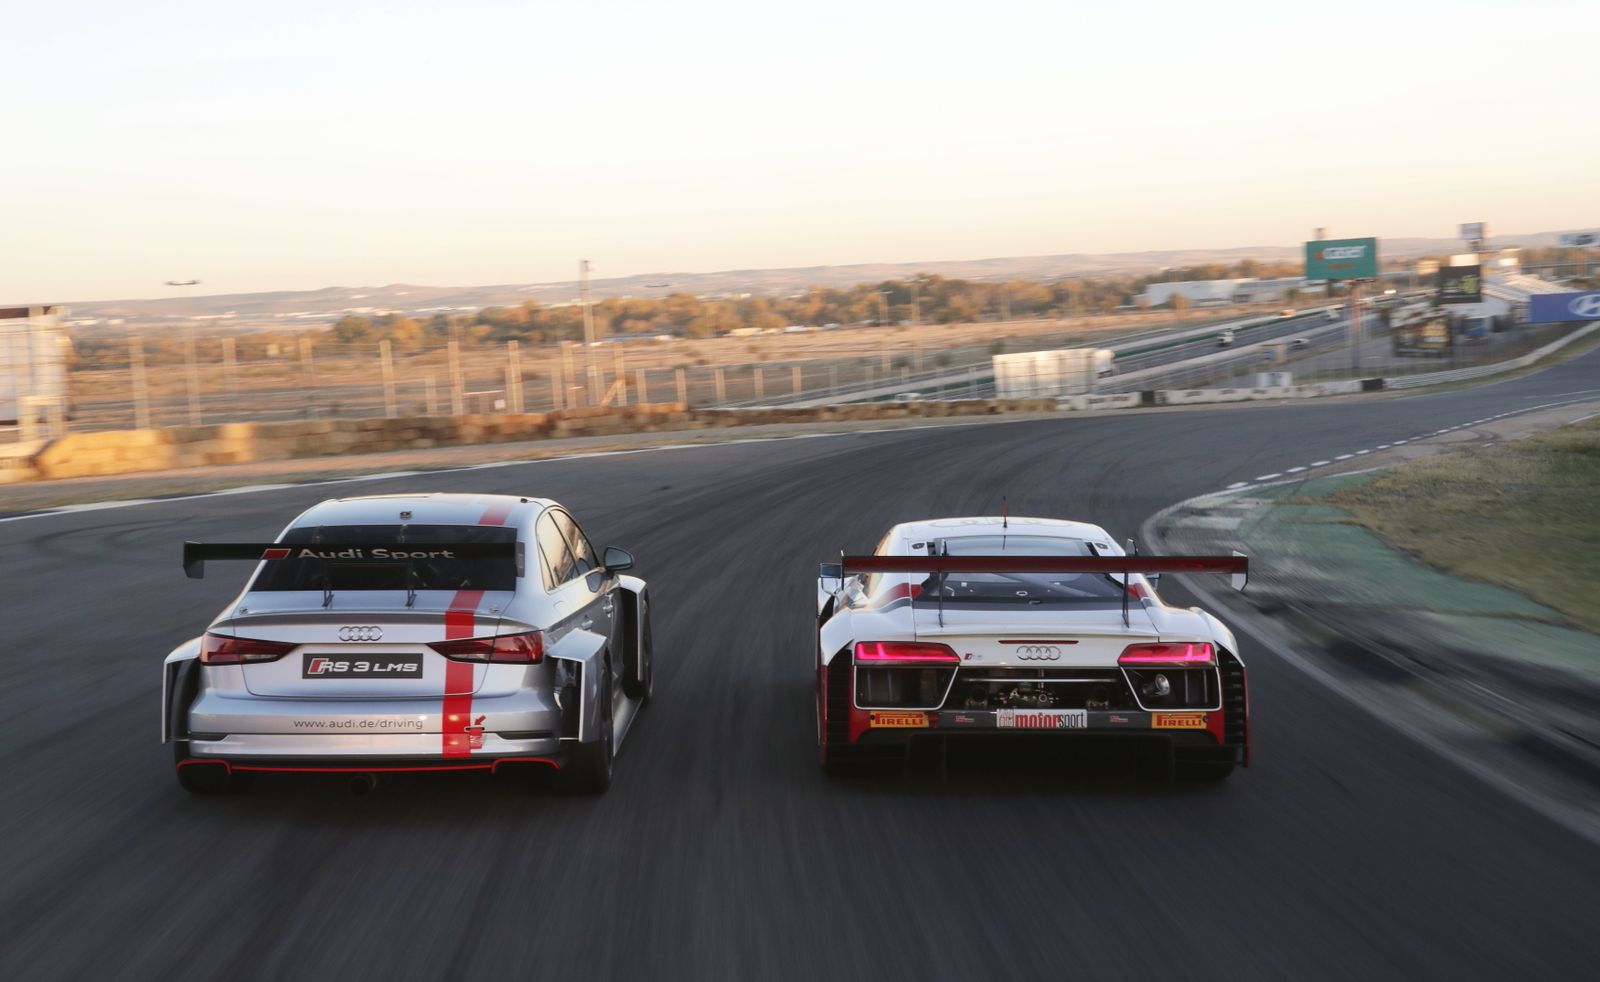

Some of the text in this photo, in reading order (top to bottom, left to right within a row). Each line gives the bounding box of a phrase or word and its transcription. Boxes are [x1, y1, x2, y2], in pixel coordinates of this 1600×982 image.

[298, 549, 455, 559] Audi Sport
[317, 661, 418, 673] RS 3 LMS
[293, 719, 423, 730] www.audi.de/driving
[874, 712, 924, 726] PIRELLI
[1014, 712, 1085, 729] motorsport
[1156, 713, 1203, 727] PIRELLI
